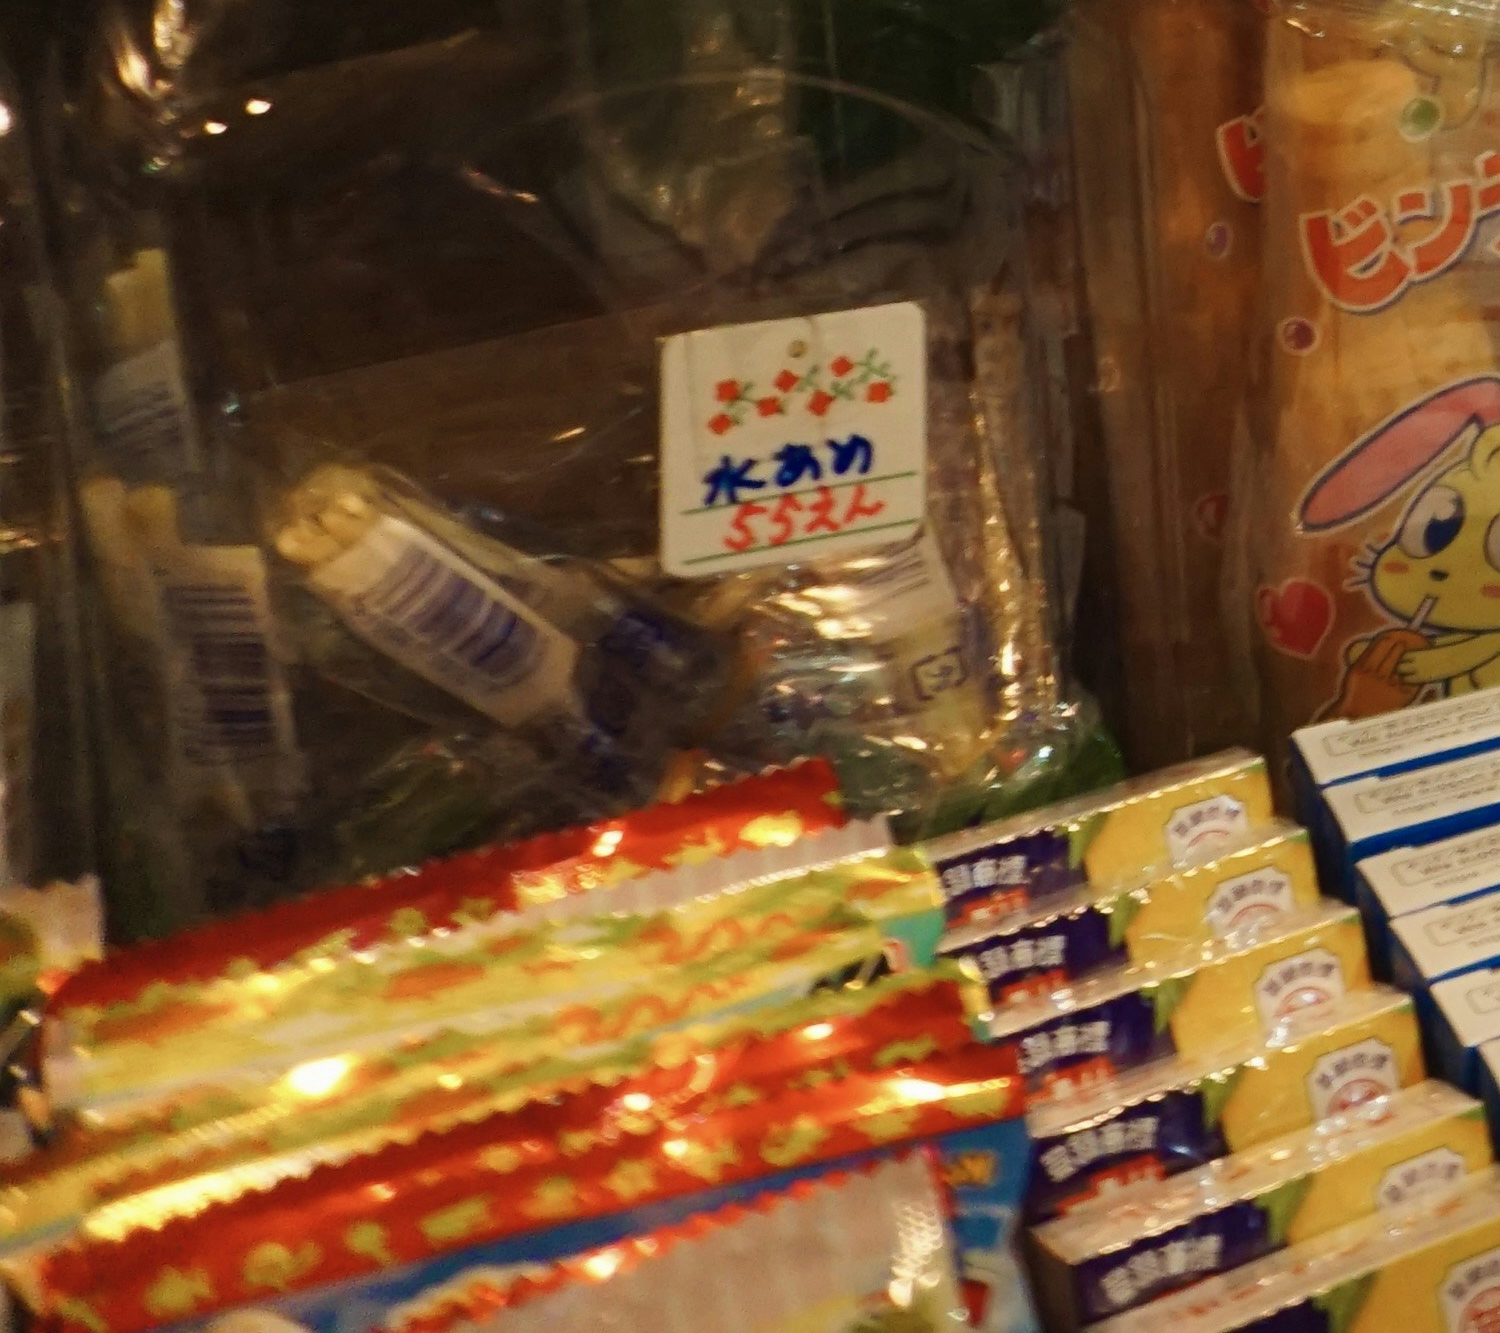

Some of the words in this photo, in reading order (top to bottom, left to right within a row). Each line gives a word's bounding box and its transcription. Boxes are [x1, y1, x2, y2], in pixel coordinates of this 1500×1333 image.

[702, 433, 874, 506] 水あめ
[721, 489, 886, 553] 55えん
